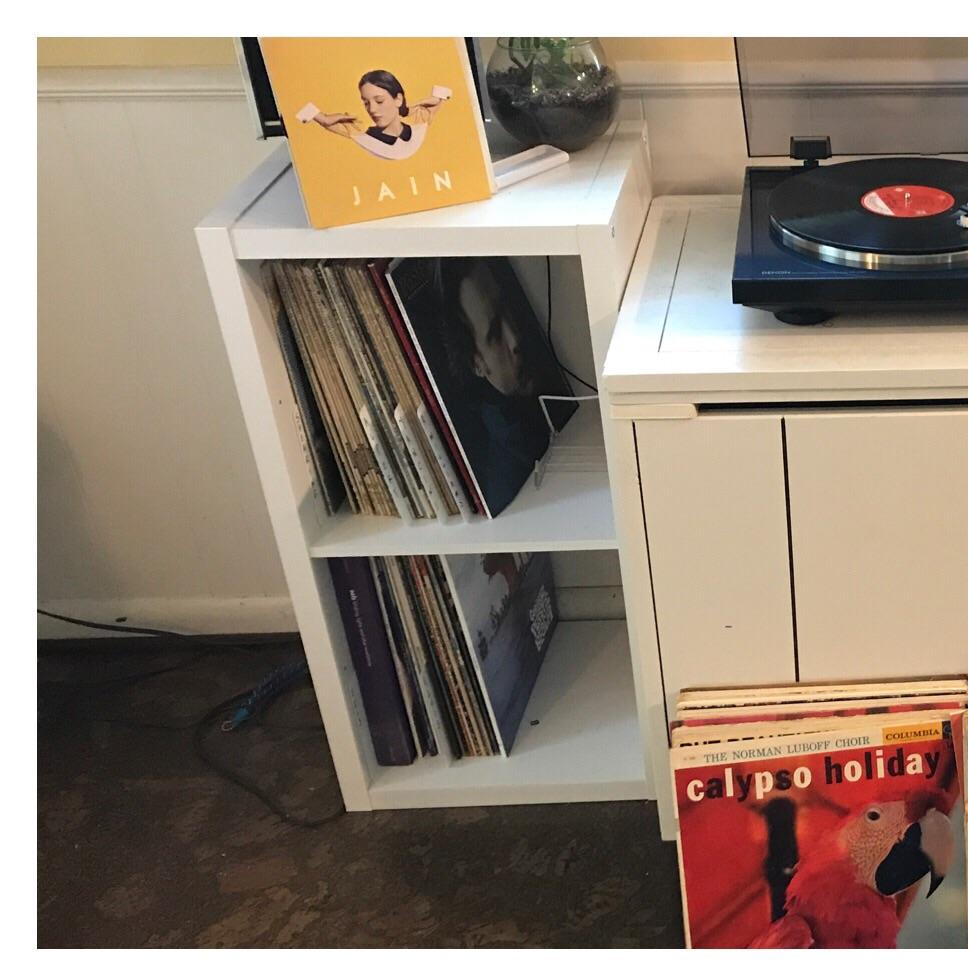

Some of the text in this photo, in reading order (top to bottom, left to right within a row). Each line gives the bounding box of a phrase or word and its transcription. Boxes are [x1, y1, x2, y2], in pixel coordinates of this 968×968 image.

[353, 170, 452, 206] JAIN
[704, 751, 728, 764] THE
[732, 745, 782, 761] NORMAN
[787, 740, 831, 754] LUBOFF
[835, 735, 870, 748] CHOIR
[885, 728, 940, 741] COLUMBIA
[686, 748, 940, 802] calypso holiday
